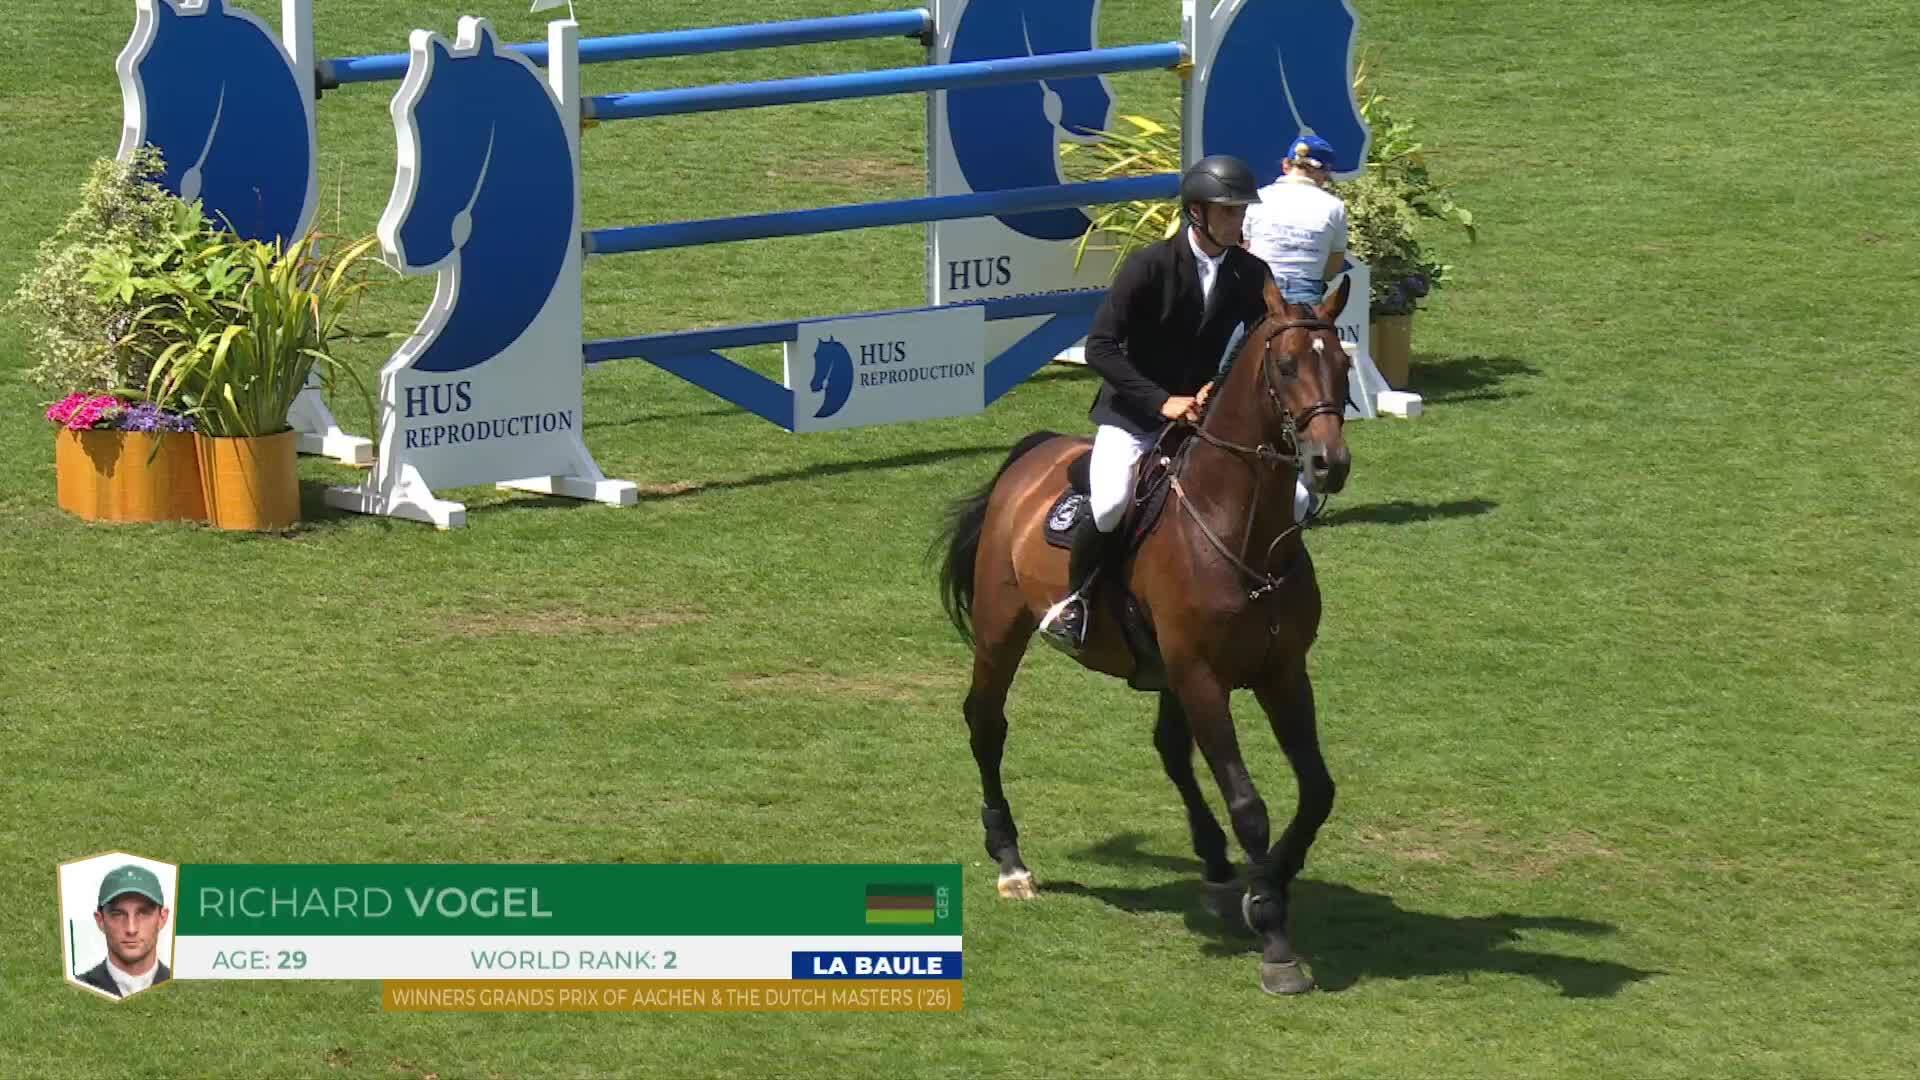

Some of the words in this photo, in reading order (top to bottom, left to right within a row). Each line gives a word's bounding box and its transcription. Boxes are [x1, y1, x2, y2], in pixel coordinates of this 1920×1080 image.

[948, 255, 1011, 290] HUS
[860, 341, 906, 366] HUS
[860, 362, 976, 387] REPRODUCTION
[405, 381, 471, 418] HUS
[405, 410, 573, 449] REPRODUCTION
